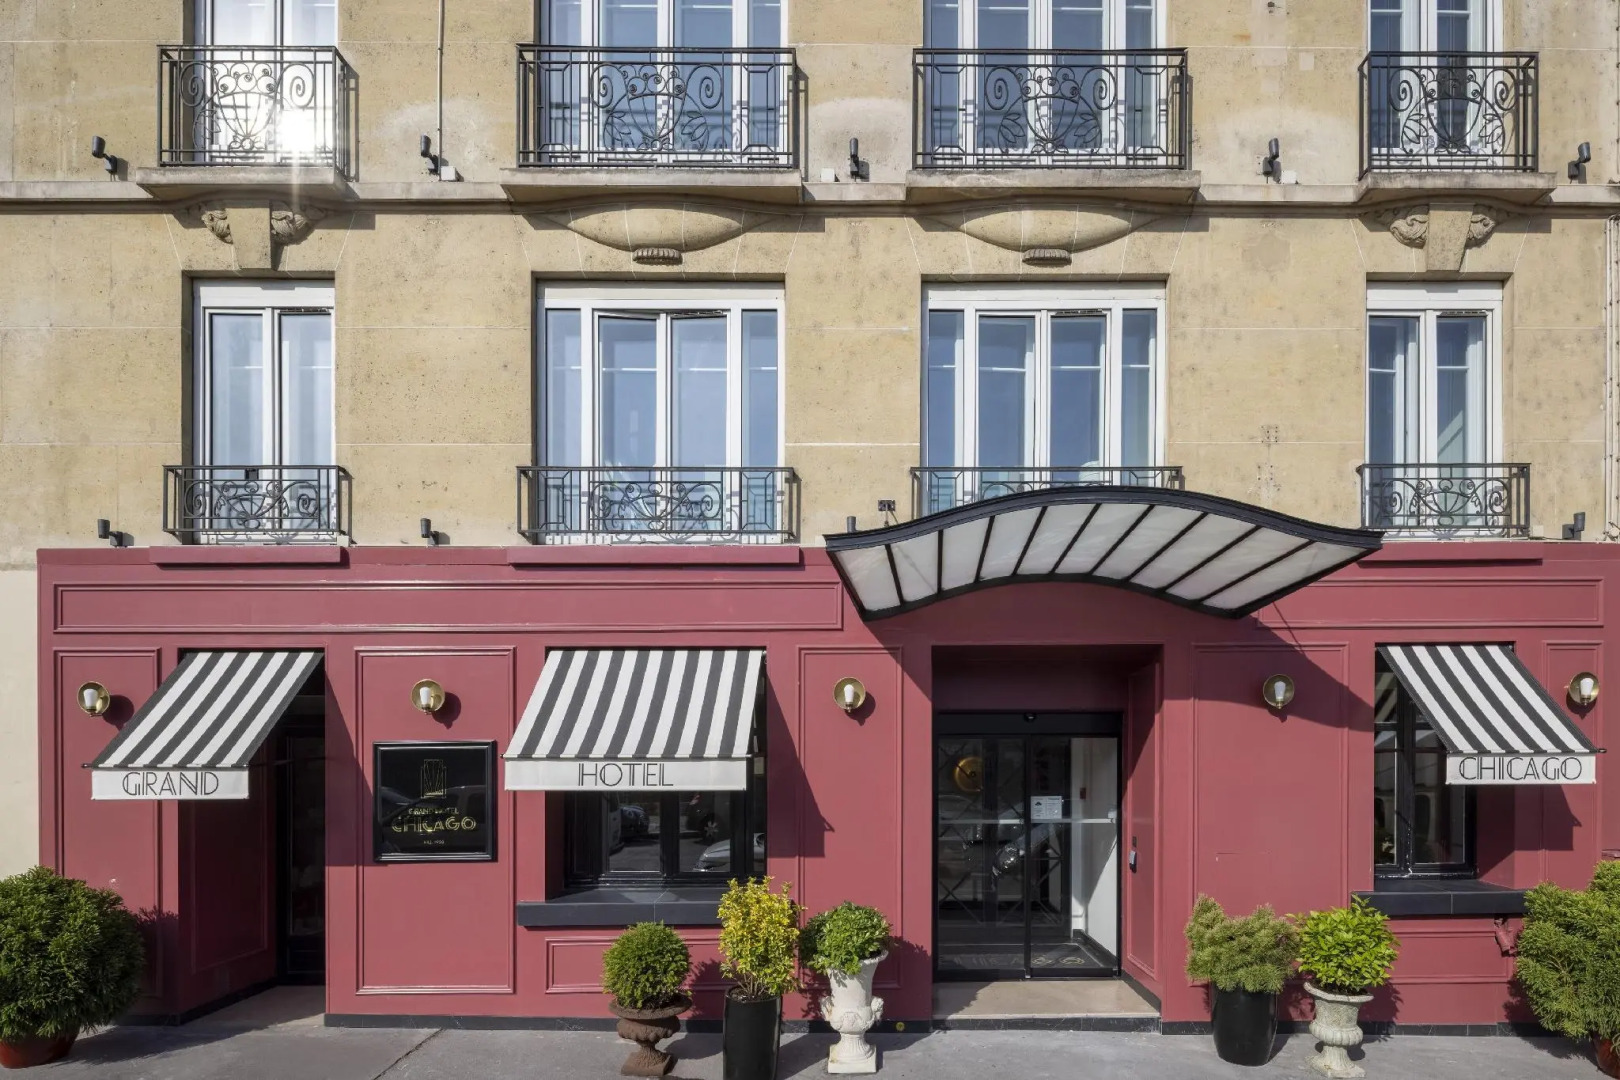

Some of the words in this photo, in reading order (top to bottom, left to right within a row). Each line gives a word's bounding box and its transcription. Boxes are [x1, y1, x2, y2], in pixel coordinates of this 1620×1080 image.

[578, 763, 674, 787] HOTEL
[1459, 756, 1583, 780] CHICAGO
[122, 771, 219, 796] GRAND
[391, 816, 477, 833] CHICAGO
